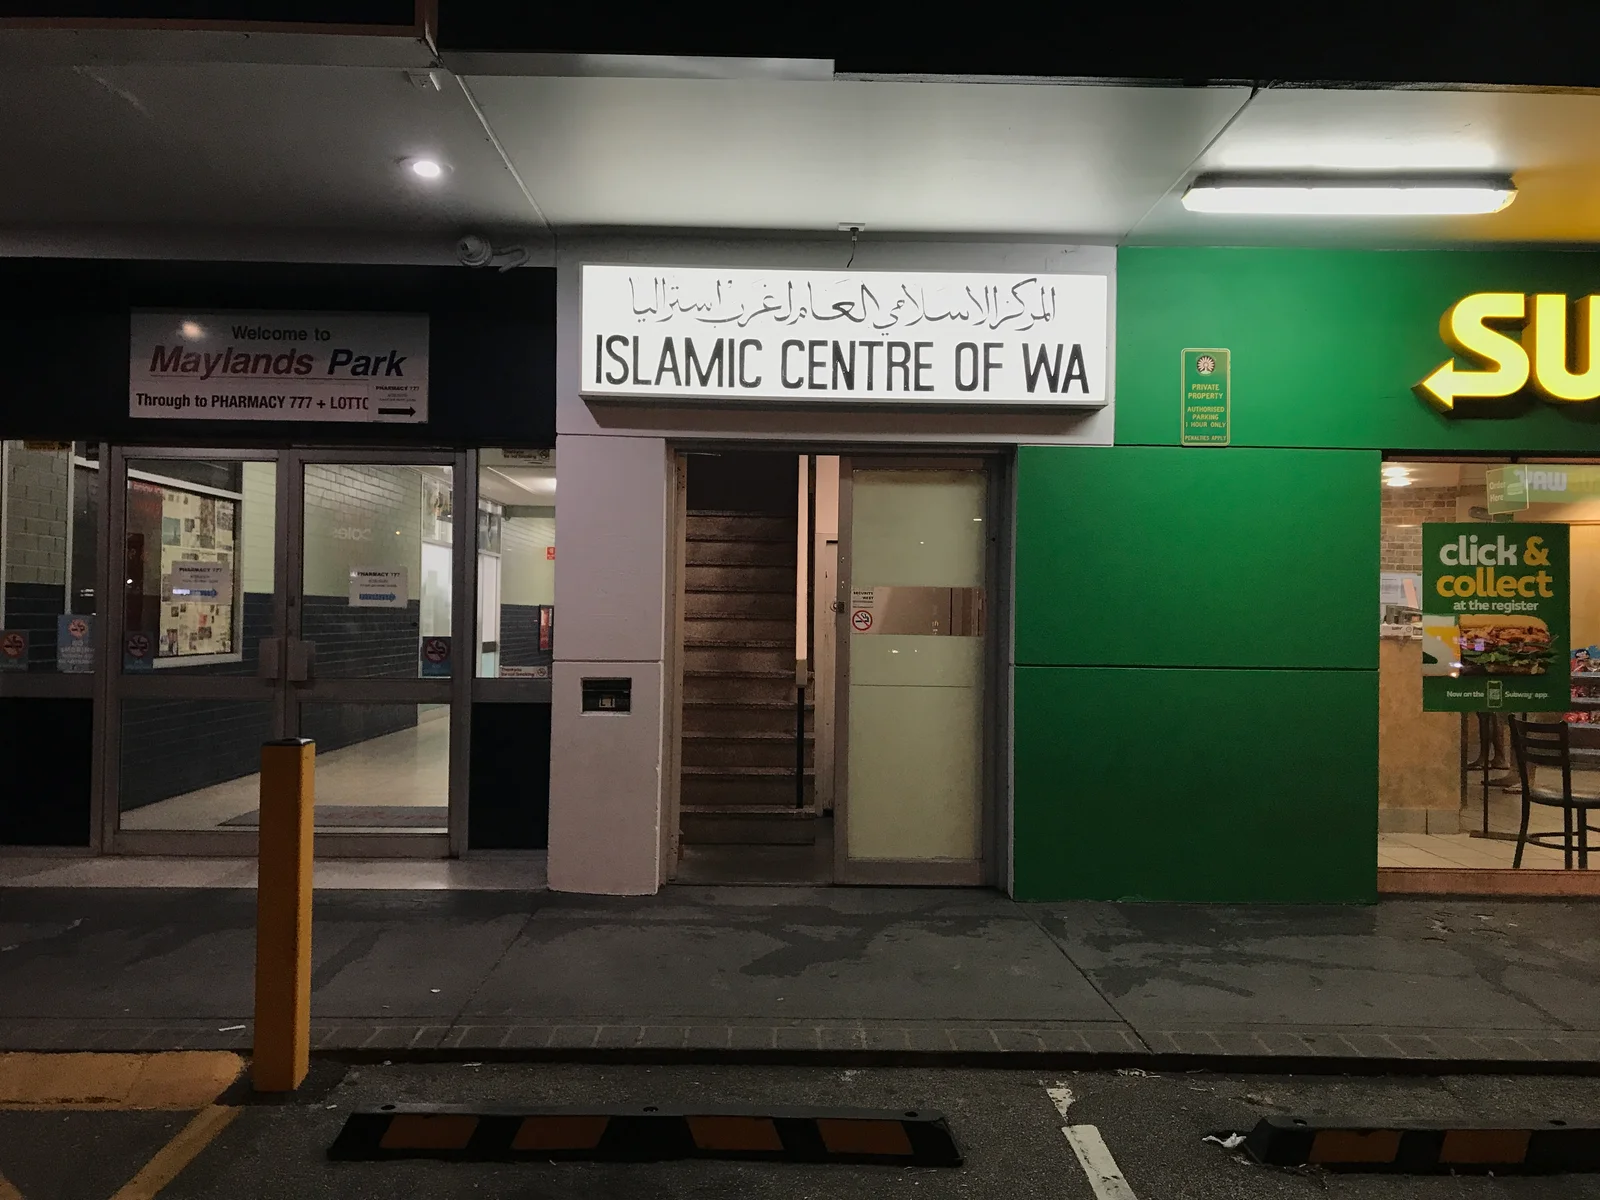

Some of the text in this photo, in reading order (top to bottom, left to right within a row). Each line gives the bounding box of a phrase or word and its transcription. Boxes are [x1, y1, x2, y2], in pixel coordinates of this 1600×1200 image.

[989, 277, 1056, 331] المركز
[231, 325, 331, 341] Welcome to
[150, 344, 407, 380] Maylands Park
[595, 334, 1090, 394] ISLAMIC CENTRE OF WA
[1191, 383, 1220, 391] PRIVATE
[136, 392, 190, 410] Through
[194, 394, 208, 408] to
[211, 394, 286, 409] PHARMACY
[290, 395, 313, 409] 777
[317, 399, 326, 408] +
[1187, 392, 1224, 400] PROPERTY
[1192, 413, 1219, 421] PARKING
[1489, 481, 1506, 490] Order
[1489, 494, 1504, 502] Here
[1439, 534, 1551, 566] click &
[1436, 566, 1555, 598] collect
[1453, 600, 1540, 614] at the register
[1504, 691, 1532, 699] Subway
